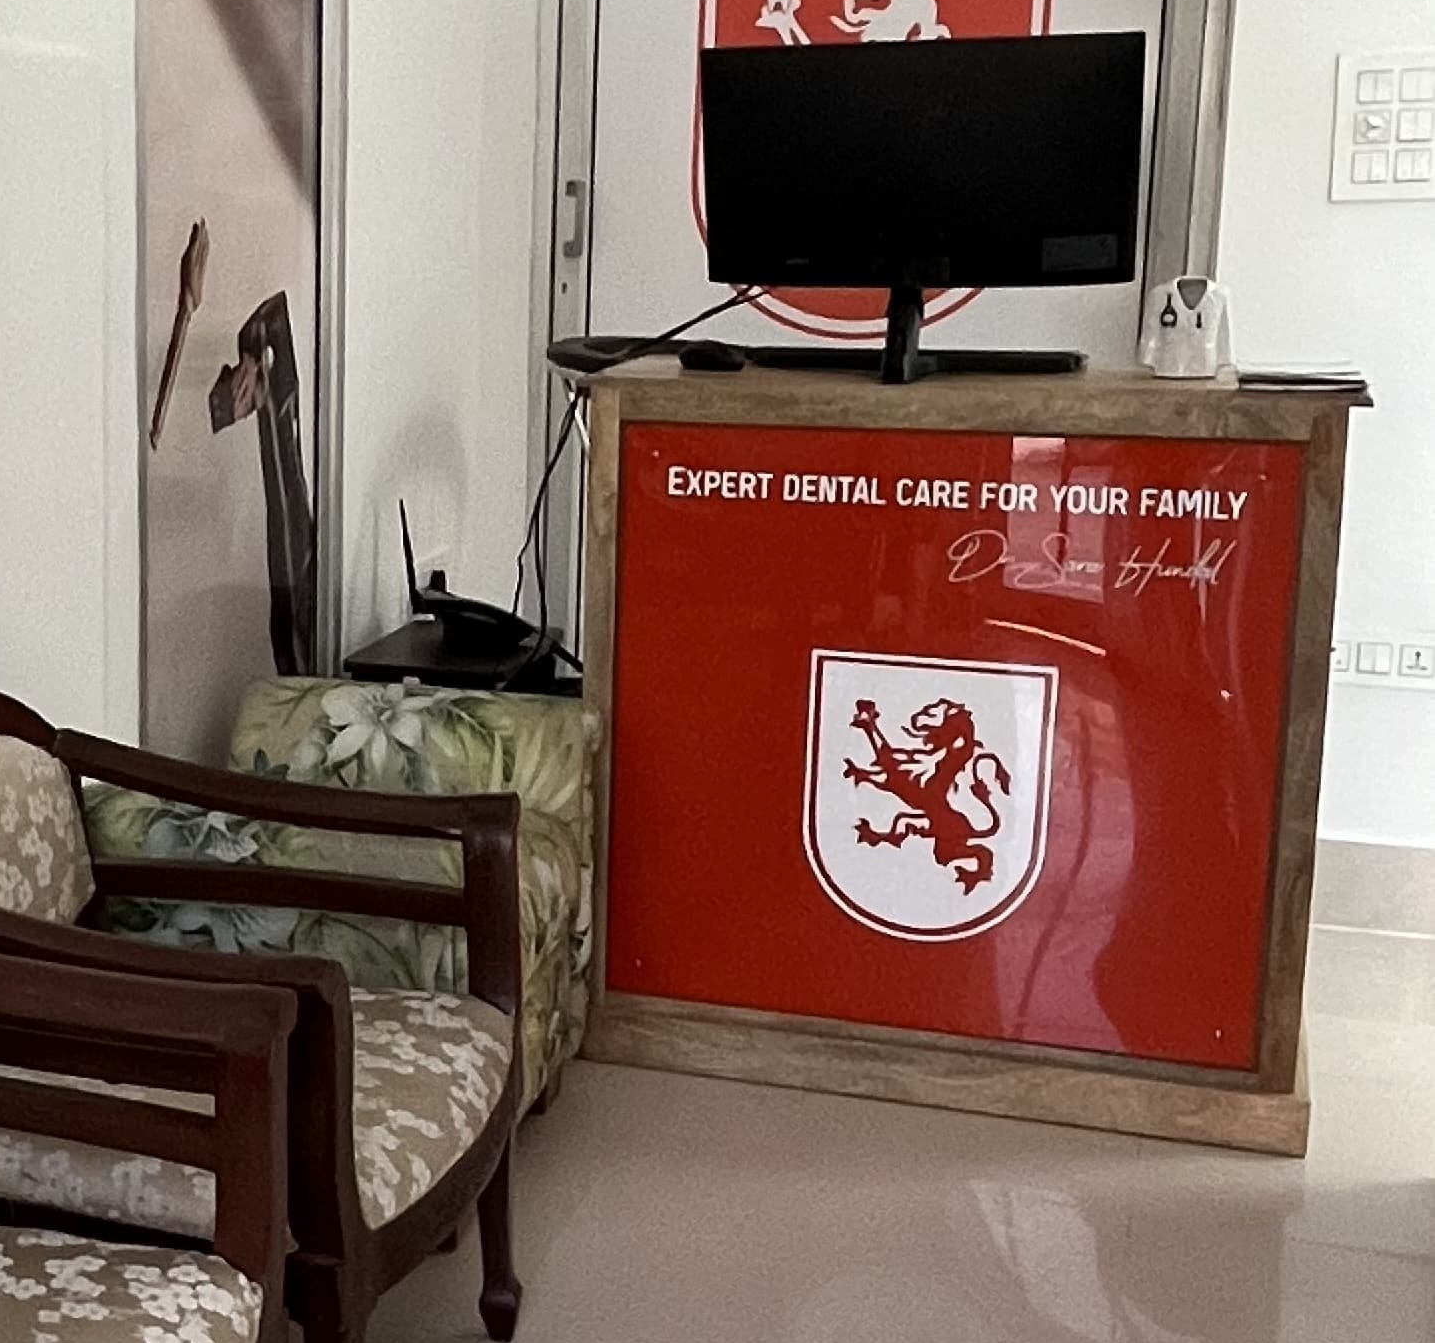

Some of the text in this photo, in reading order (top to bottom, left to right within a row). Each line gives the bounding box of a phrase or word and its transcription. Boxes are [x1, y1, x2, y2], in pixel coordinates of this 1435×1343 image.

[667, 465, 1248, 520] EXPERT DENTAL CARE FOR YOUR FAMILY
